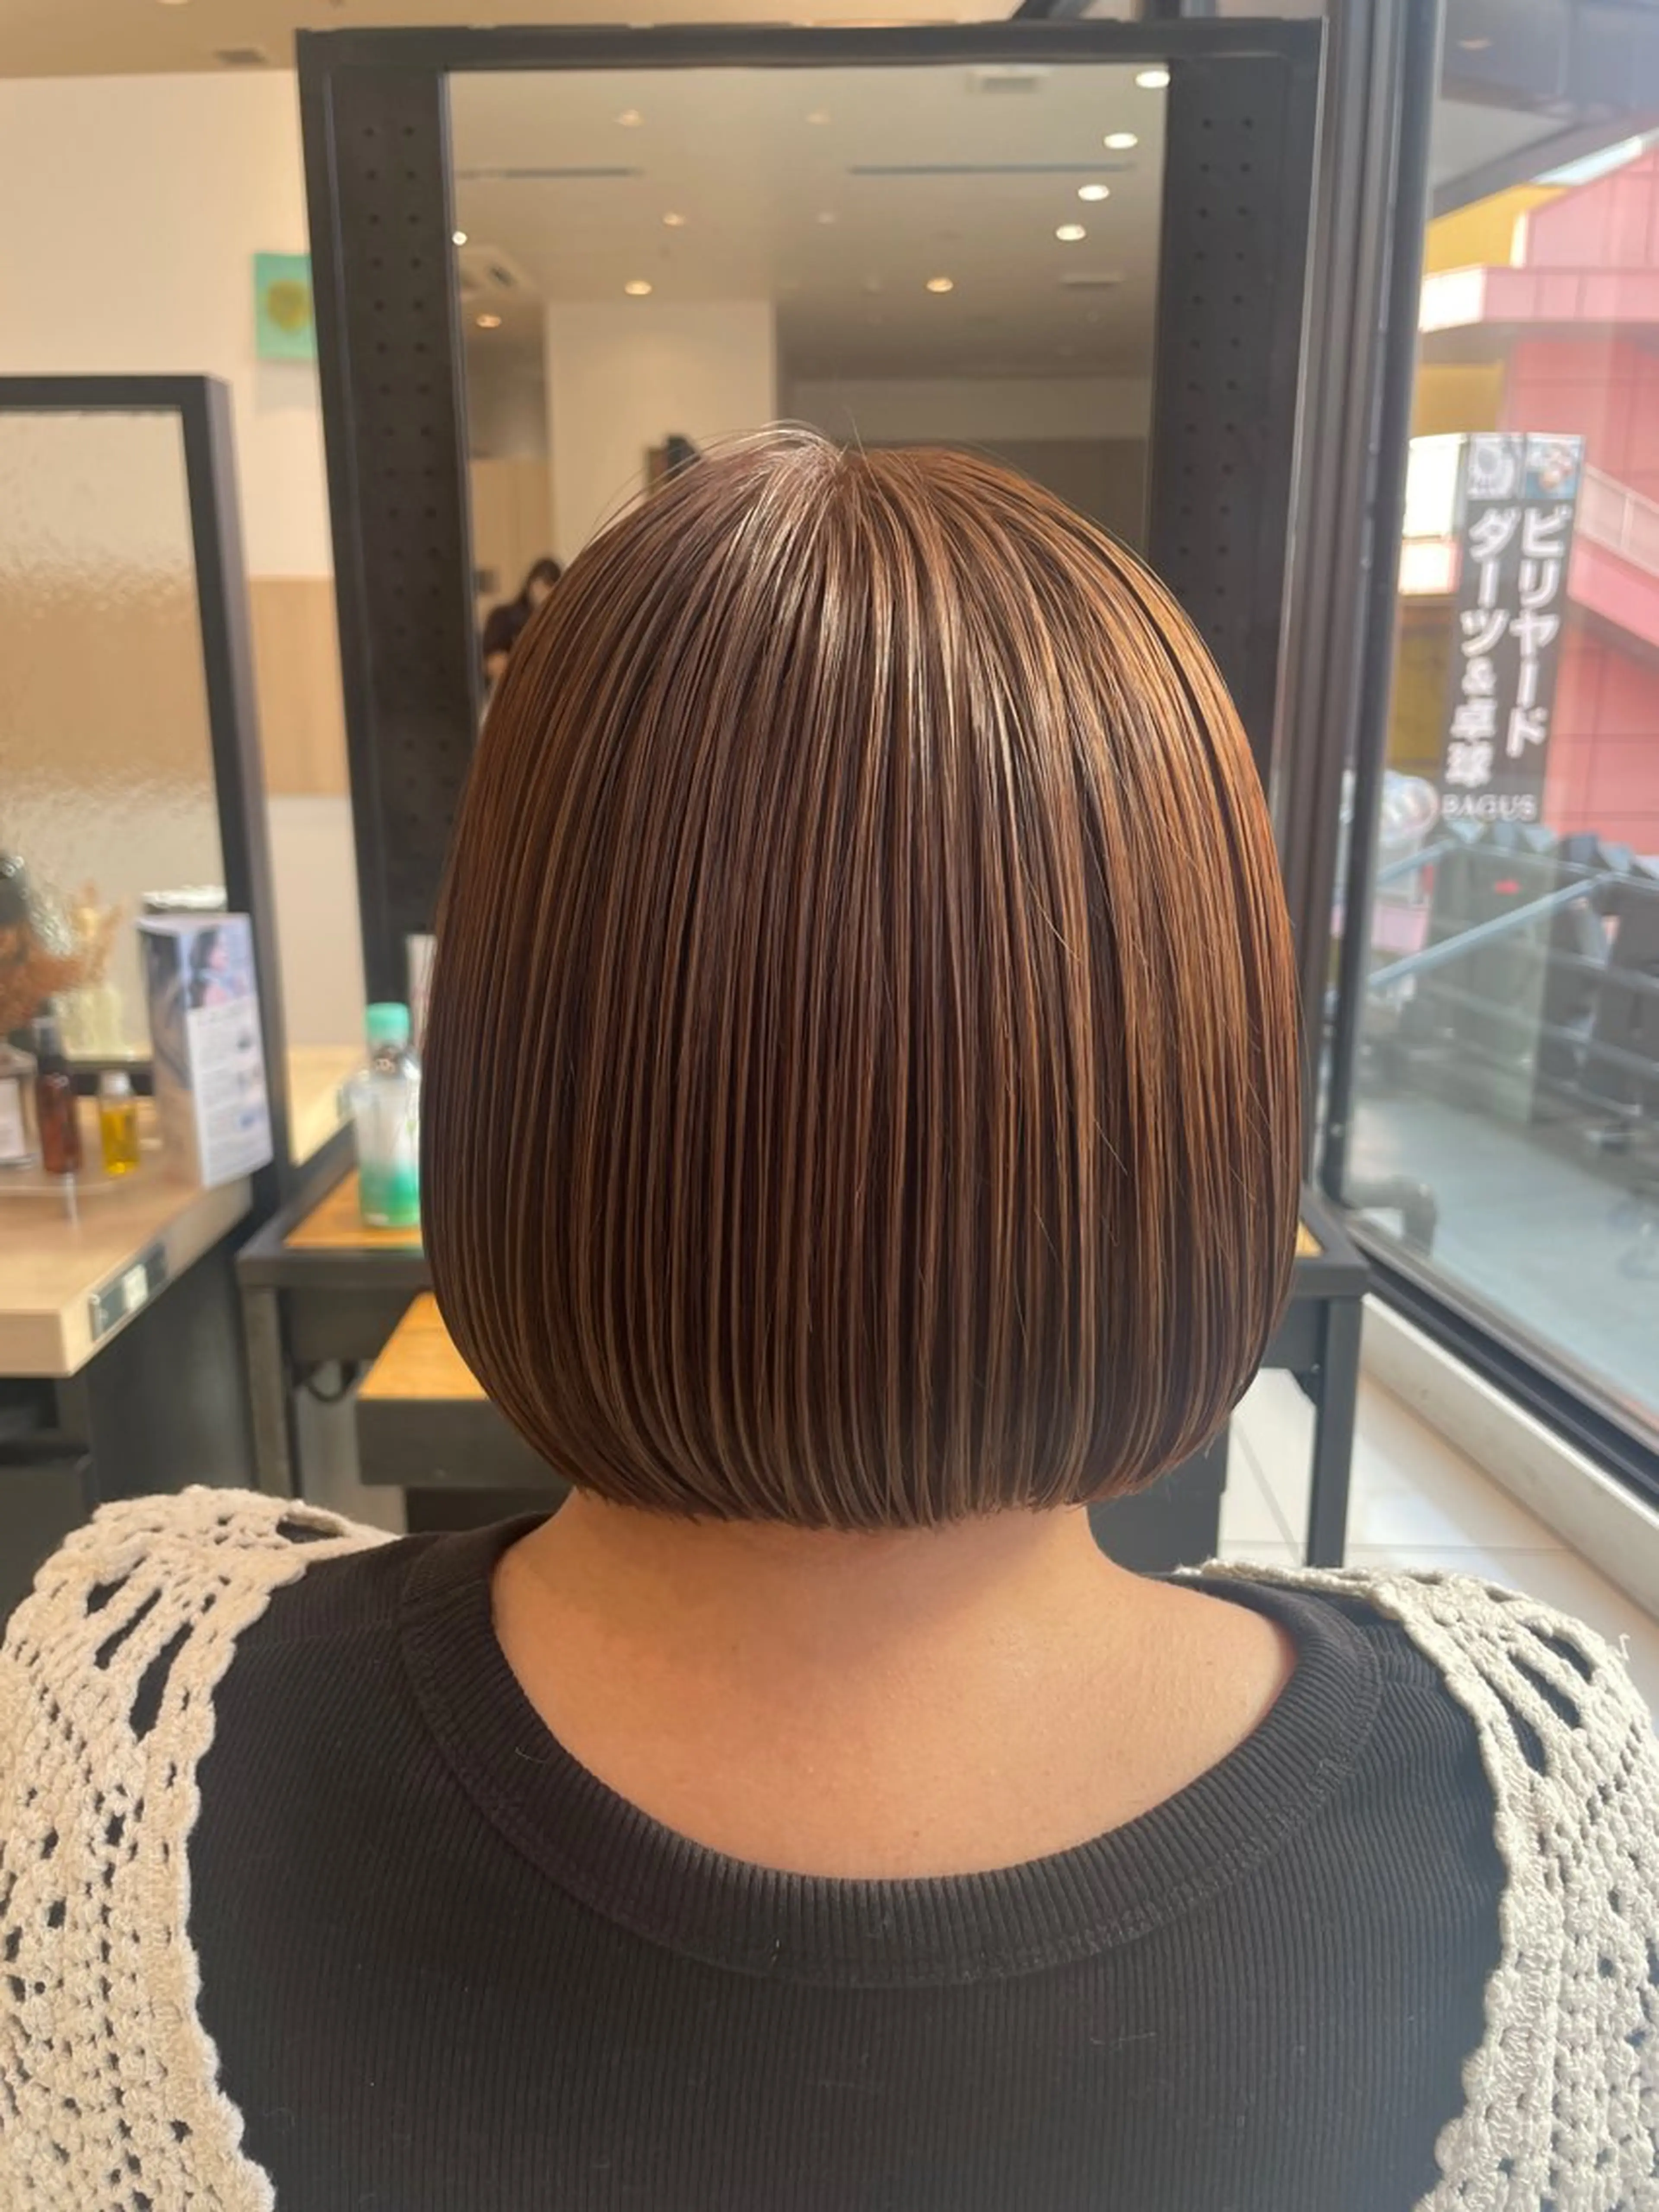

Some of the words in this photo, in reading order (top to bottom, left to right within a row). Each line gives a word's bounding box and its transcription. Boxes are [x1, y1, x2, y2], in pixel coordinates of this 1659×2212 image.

[1506, 505, 1573, 757] ビリヤード
[1442, 794, 1537, 820] BAGUS
